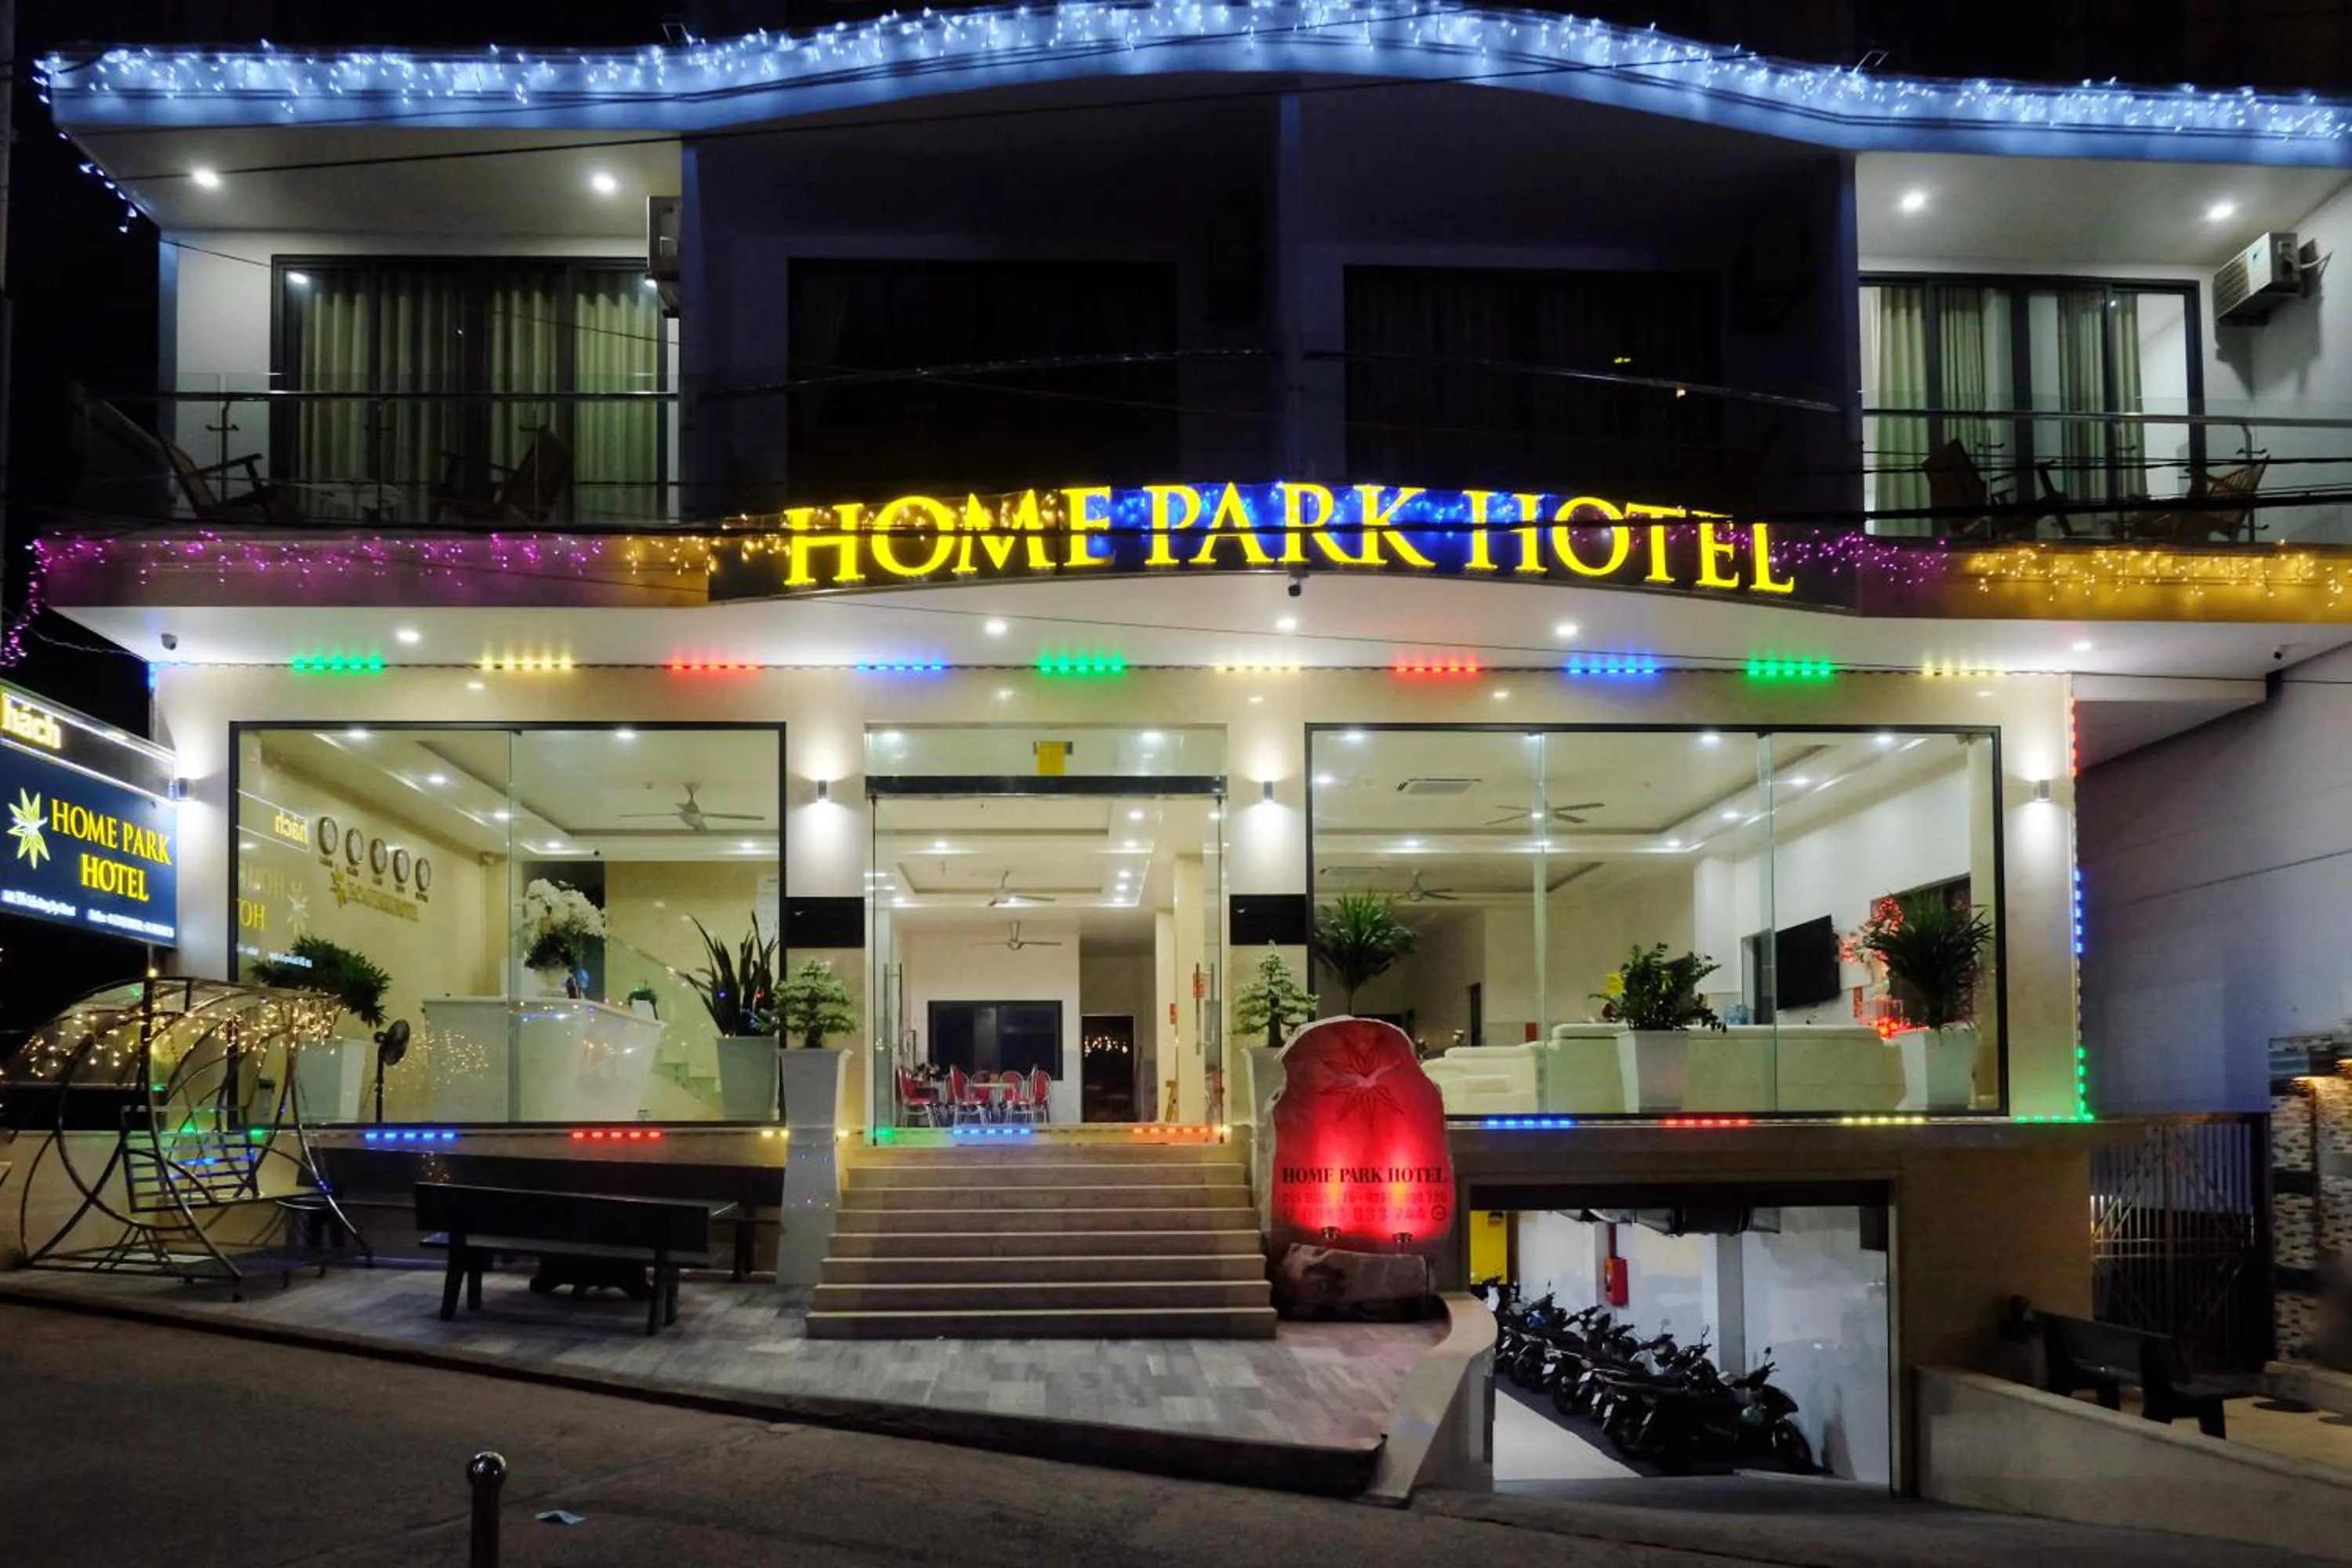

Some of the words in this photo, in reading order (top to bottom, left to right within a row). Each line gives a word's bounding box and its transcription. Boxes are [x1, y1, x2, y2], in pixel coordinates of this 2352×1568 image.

[783, 485, 1112, 586] HOME
[1142, 481, 1436, 568] PARK
[1462, 489, 1795, 593] HOTEL
[50, 797, 118, 849] HOME
[122, 822, 172, 866] PARK
[80, 853, 150, 902] HOTEL
[1282, 1167, 1333, 1184] HOME
[1339, 1167, 1383, 1184] PARK
[1388, 1167, 1446, 1184] HOTEL
